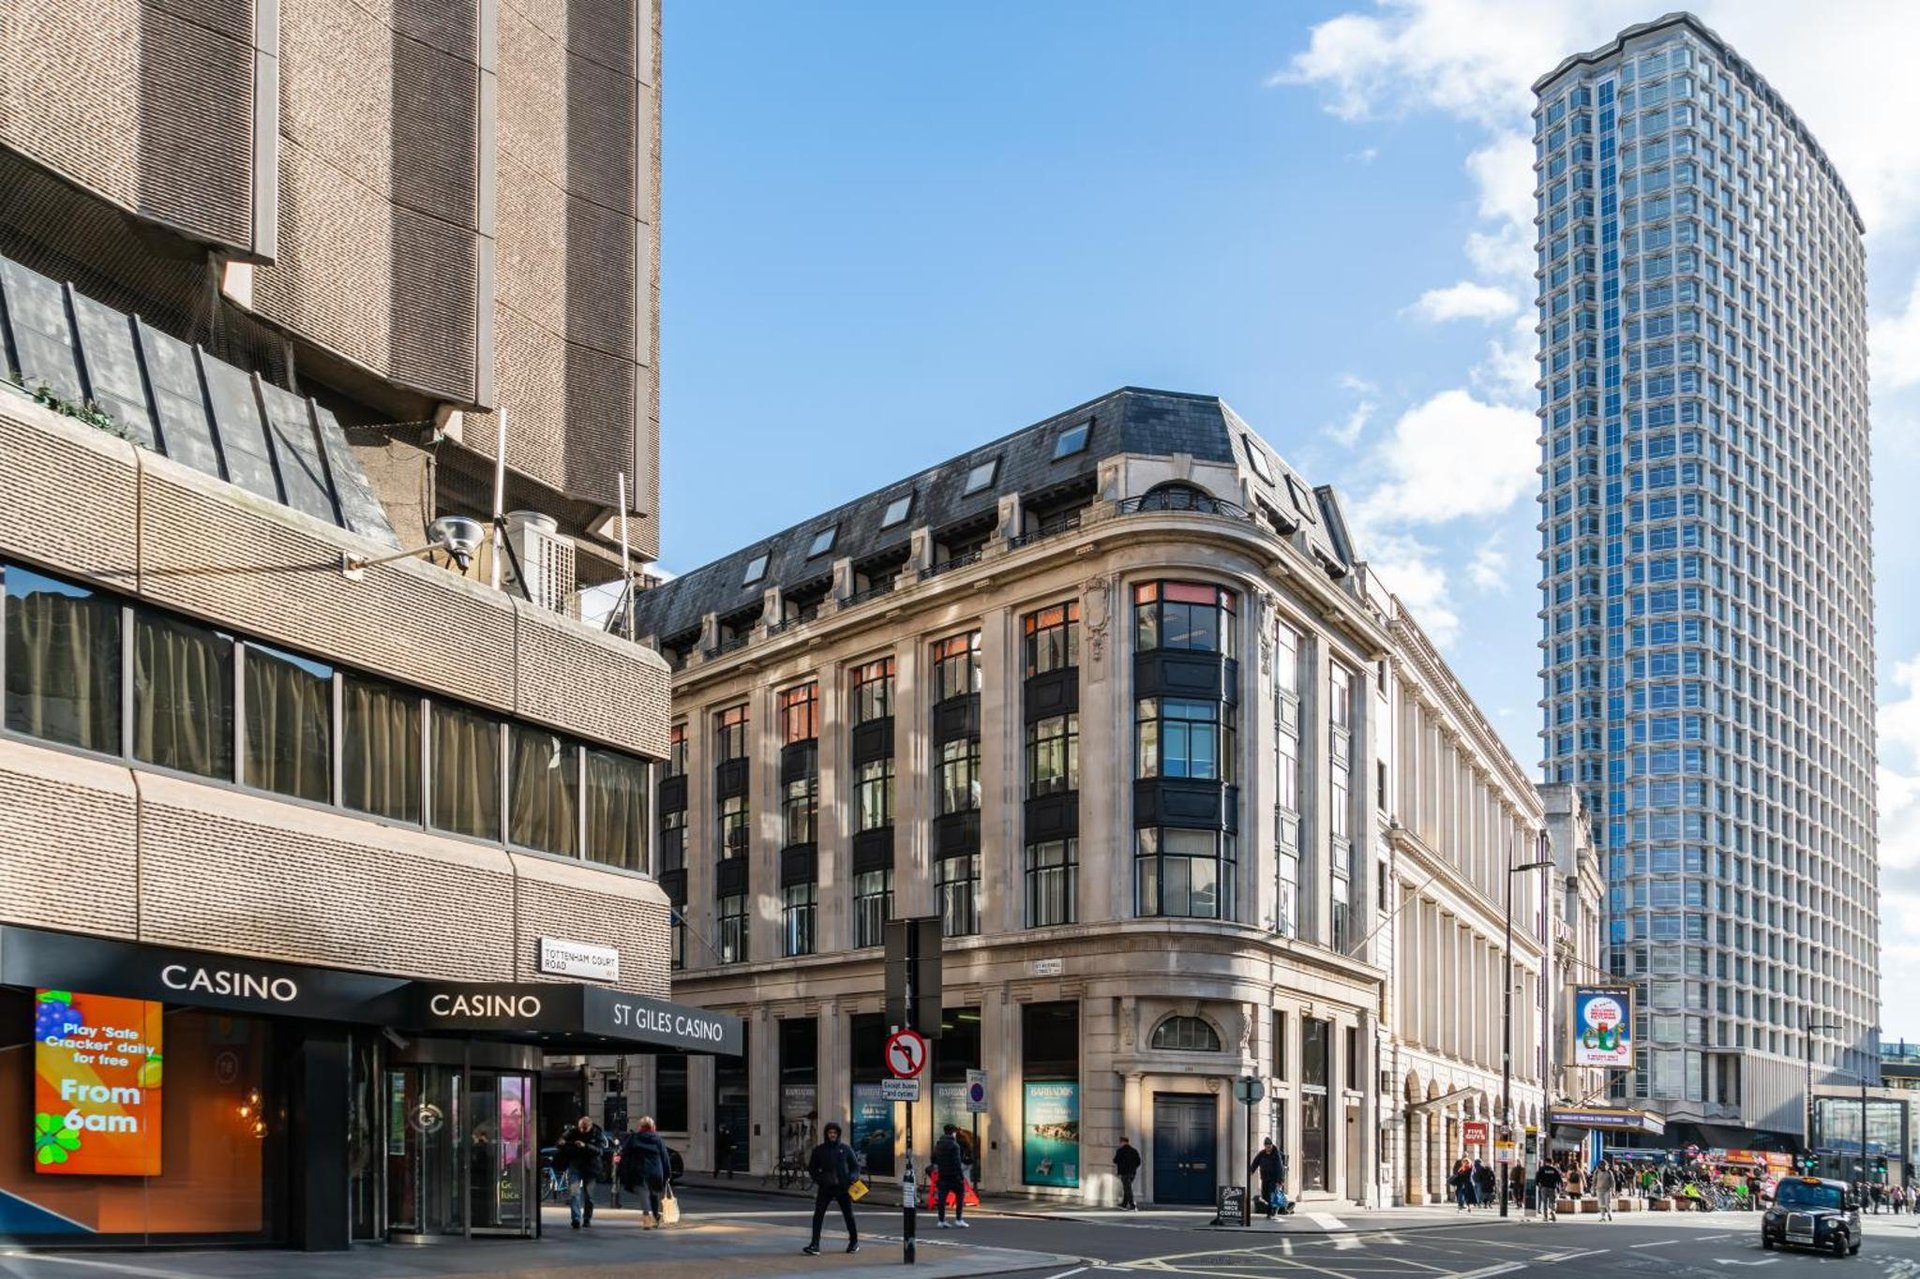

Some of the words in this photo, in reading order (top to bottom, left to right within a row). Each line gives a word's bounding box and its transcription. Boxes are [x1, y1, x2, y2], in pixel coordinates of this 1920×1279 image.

[545, 949, 590, 963] TOTTENHAM
[592, 955, 615, 967] COURT
[545, 959, 566, 970] ROAD
[162, 965, 297, 1001] CASINO
[430, 994, 541, 1018] CASINO
[63, 1023, 97, 1038] Play
[102, 1026, 139, 1040] 'Safe
[614, 1003, 632, 1026] ST
[636, 1008, 672, 1033] GILES
[676, 1016, 723, 1042] CASINO
[45, 1035, 112, 1051] Cracker'
[117, 1042, 155, 1057] daily
[73, 1052, 95, 1064] for
[99, 1054, 129, 1067] free
[61, 1079, 140, 1105] From
[64, 1108, 138, 1133] 6am
